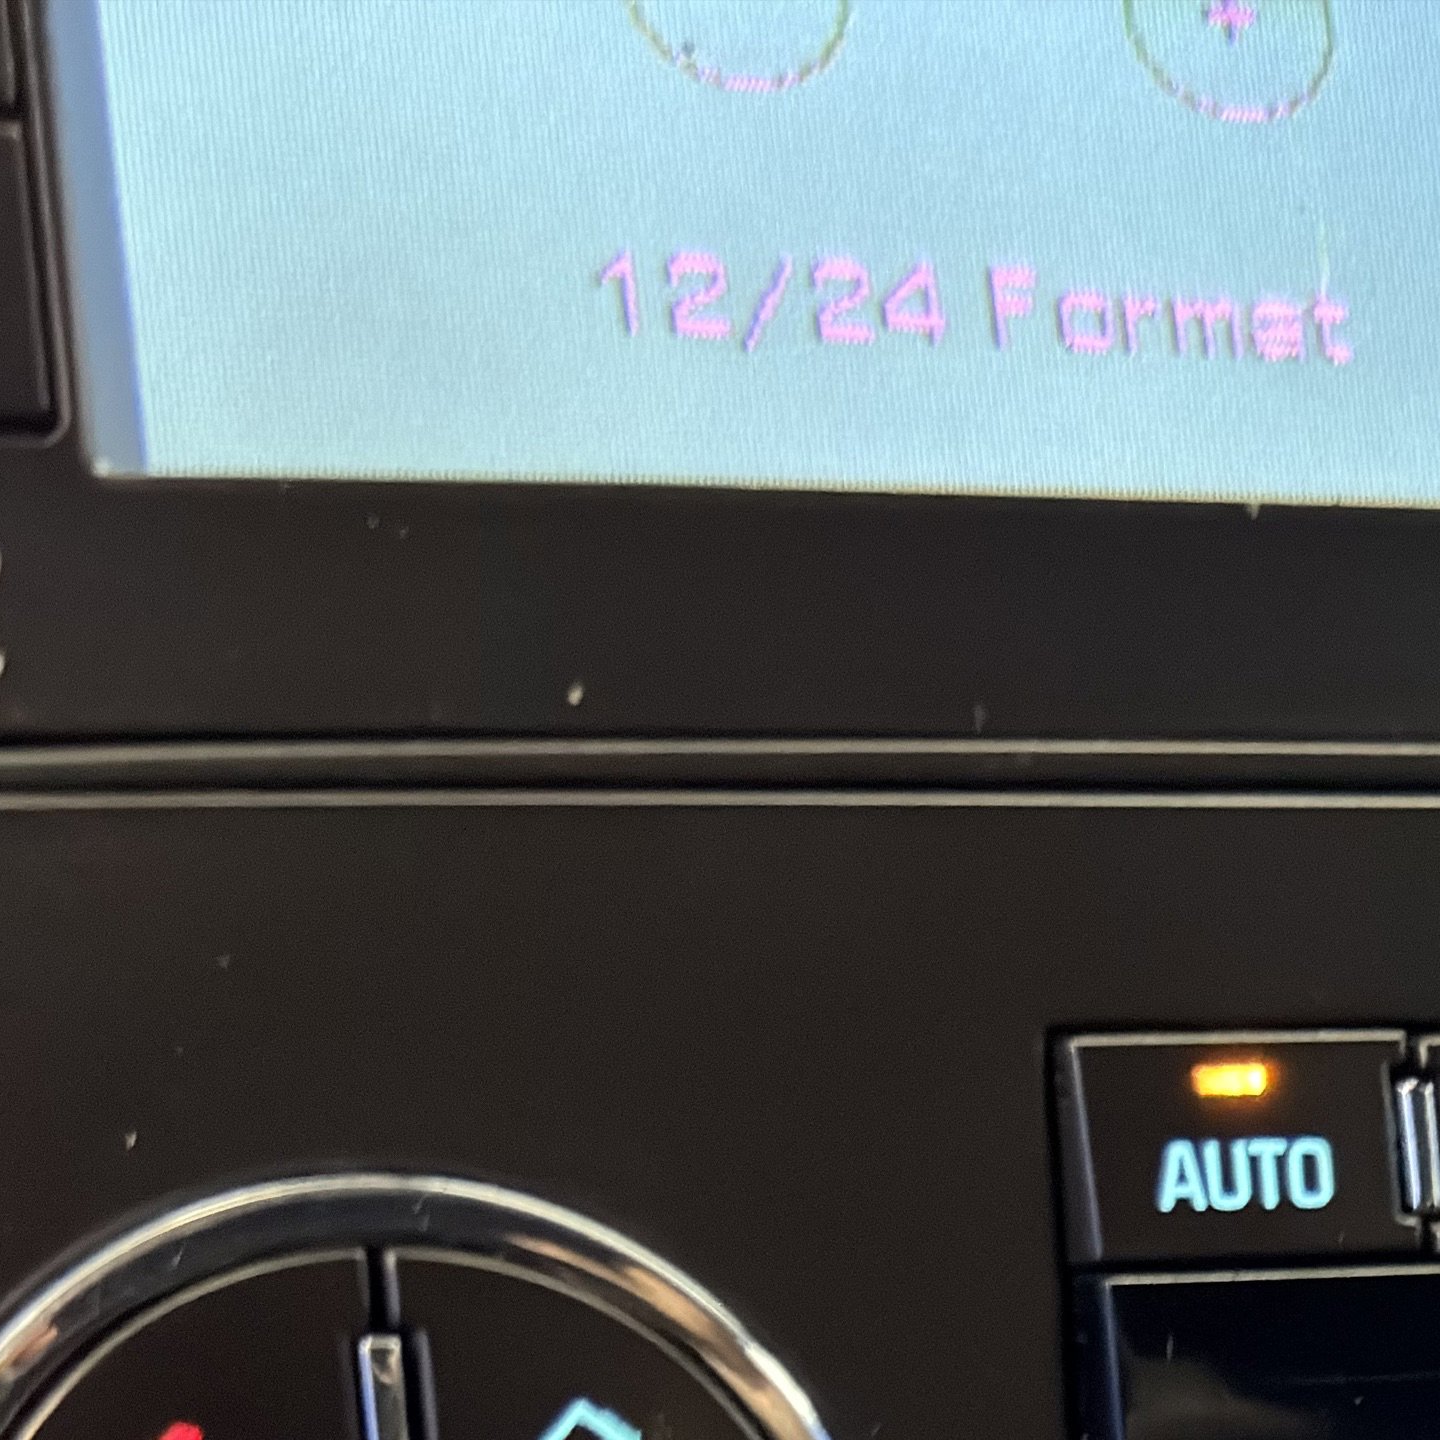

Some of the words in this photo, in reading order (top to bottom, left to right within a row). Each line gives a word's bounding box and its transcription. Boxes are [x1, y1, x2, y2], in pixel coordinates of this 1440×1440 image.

[598, 252, 946, 352] 12/24
[988, 266, 1352, 364] Format
[1157, 1135, 1335, 1213] AUTO
